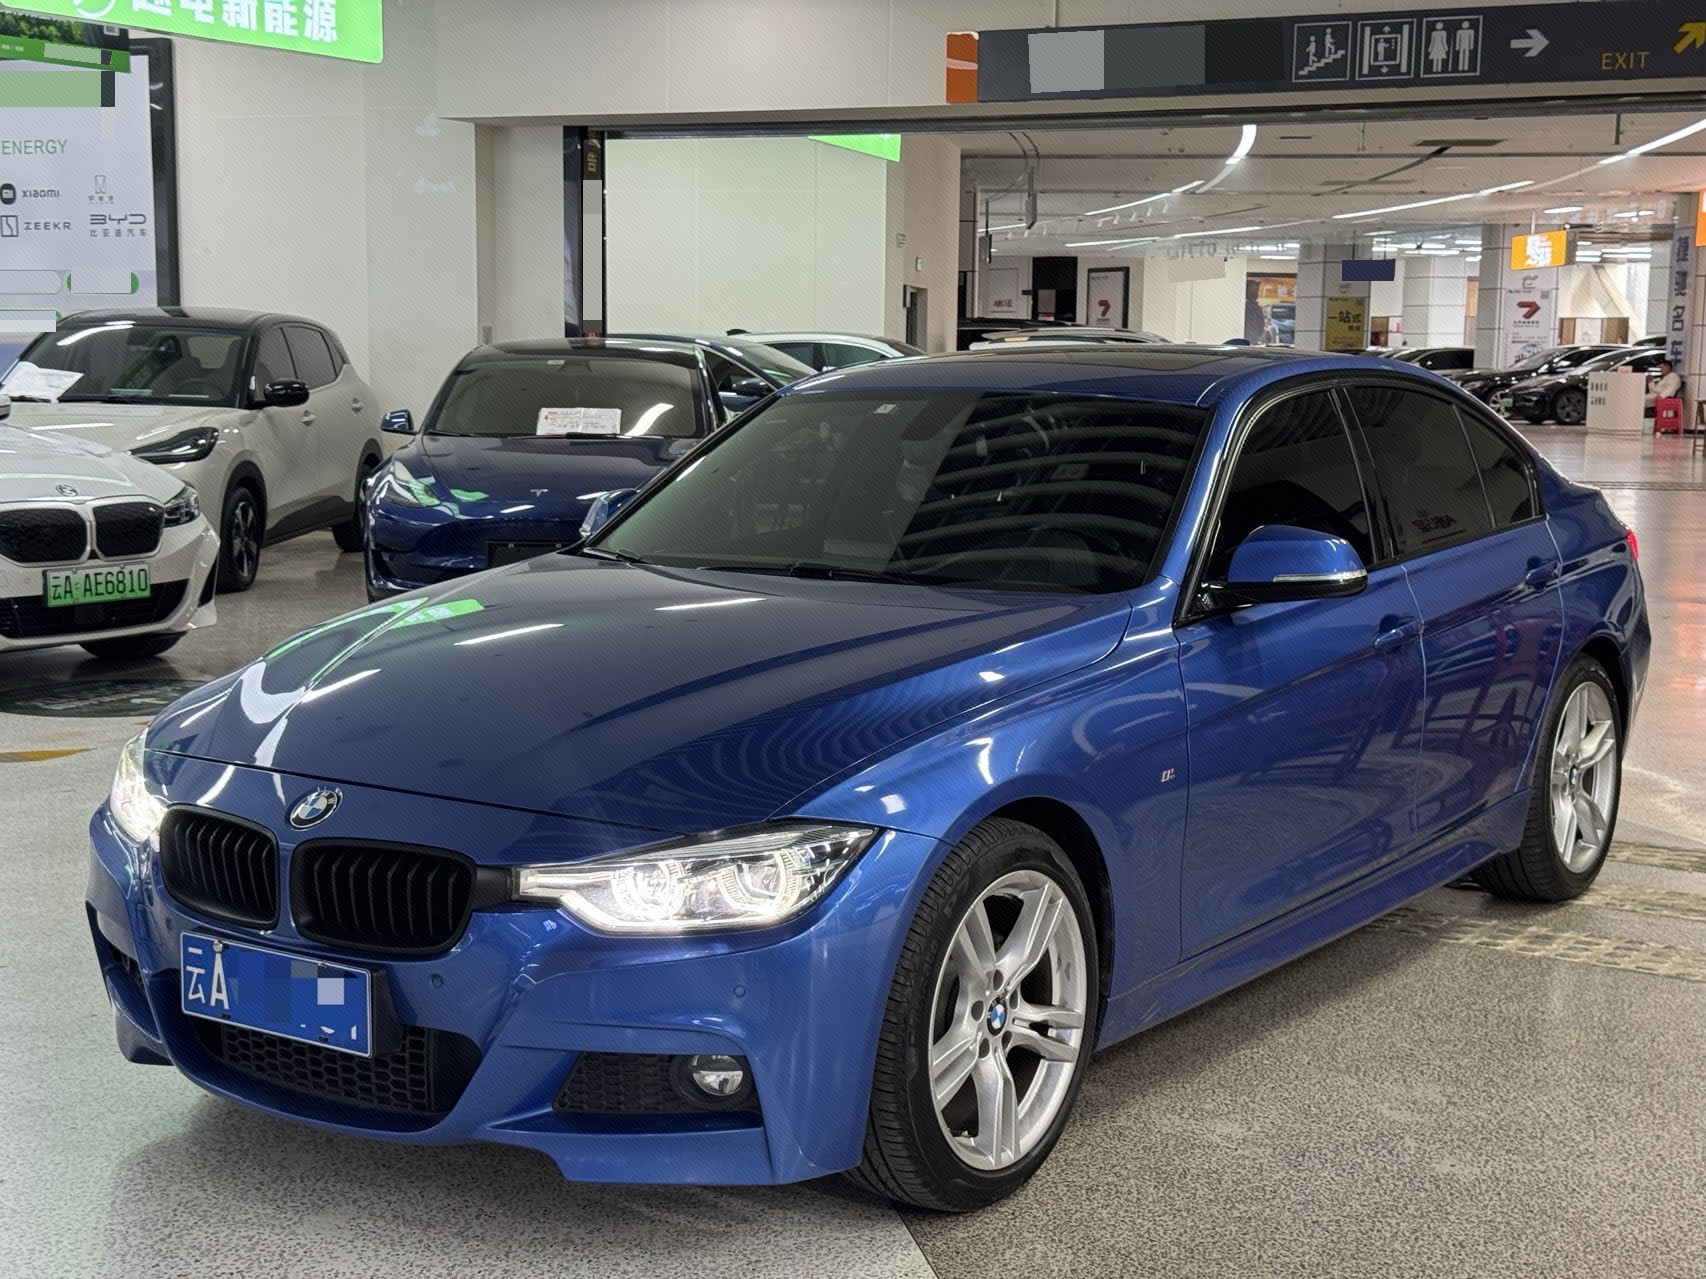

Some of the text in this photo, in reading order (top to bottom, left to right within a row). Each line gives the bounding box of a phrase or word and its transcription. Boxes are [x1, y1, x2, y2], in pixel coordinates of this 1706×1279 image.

[1601, 51, 1650, 70] EXIT
[1, 139, 68, 155] ENERGY
[23, 221, 72, 231] ZEEKR
[89, 213, 147, 225] BYD
